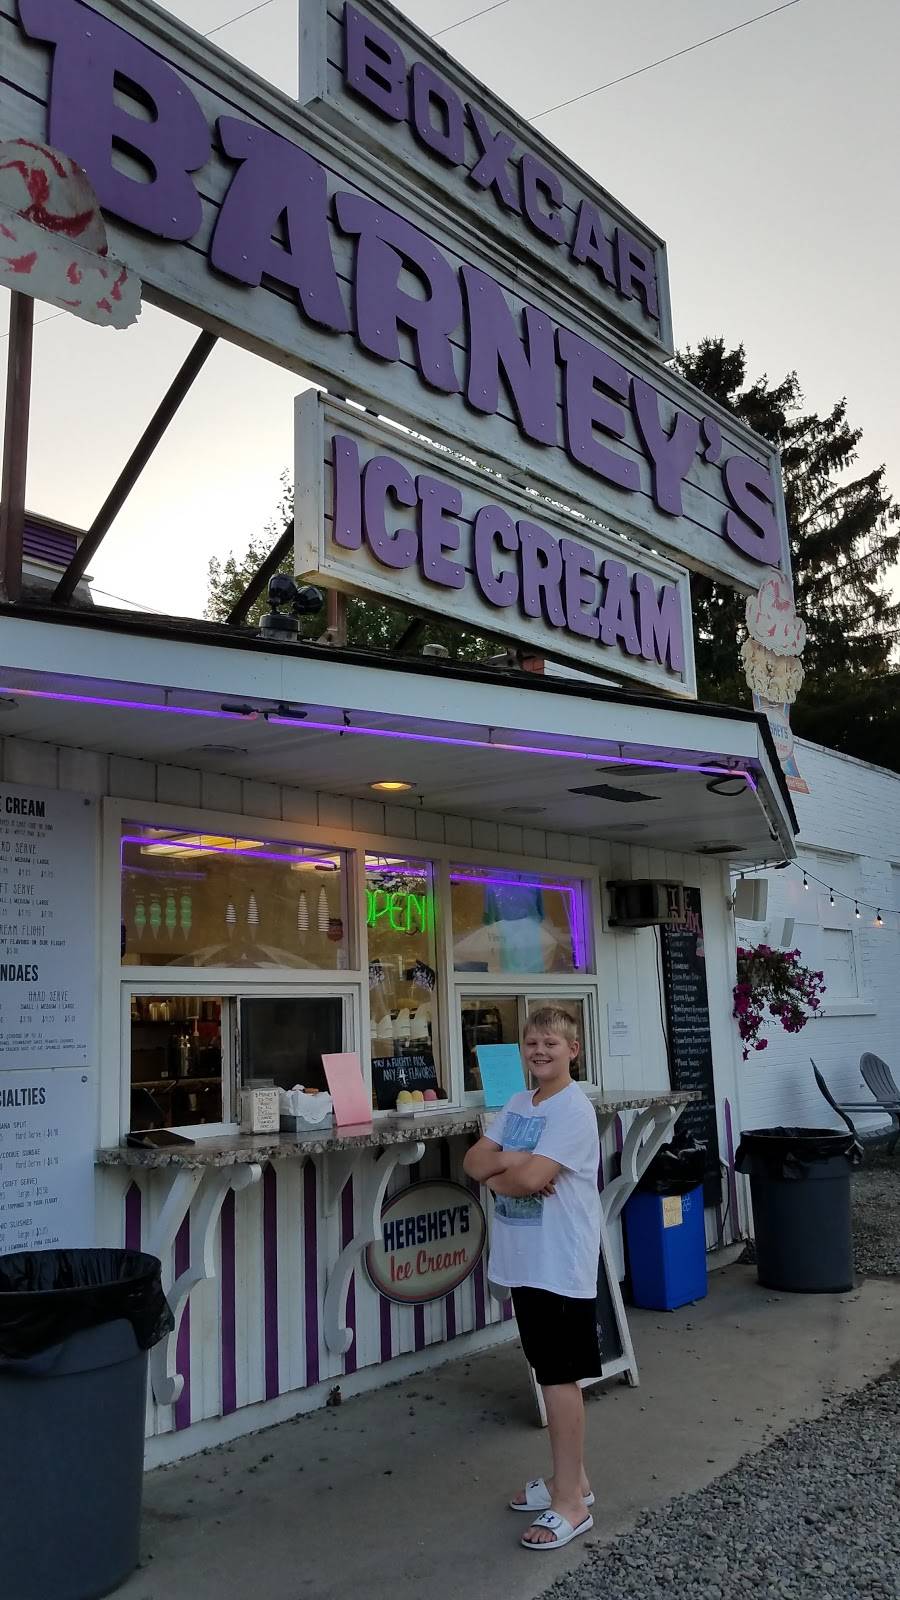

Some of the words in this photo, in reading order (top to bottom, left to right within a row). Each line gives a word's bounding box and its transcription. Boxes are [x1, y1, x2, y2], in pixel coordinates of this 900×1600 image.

[343, 1, 660, 320] BOXCAR
[18, 0, 779, 567] BARNEY'S
[331, 435, 465, 590] ICE
[474, 505, 684, 673] CREAM
[5, 796, 46, 818] CREAM
[0, 964, 39, 982] NDAES
[398, 1069, 406, 1085] 4
[383, 1204, 470, 1253] HERSHEY'S
[388, 1255, 414, 1282] Ice
[415, 1248, 467, 1276] Cream
